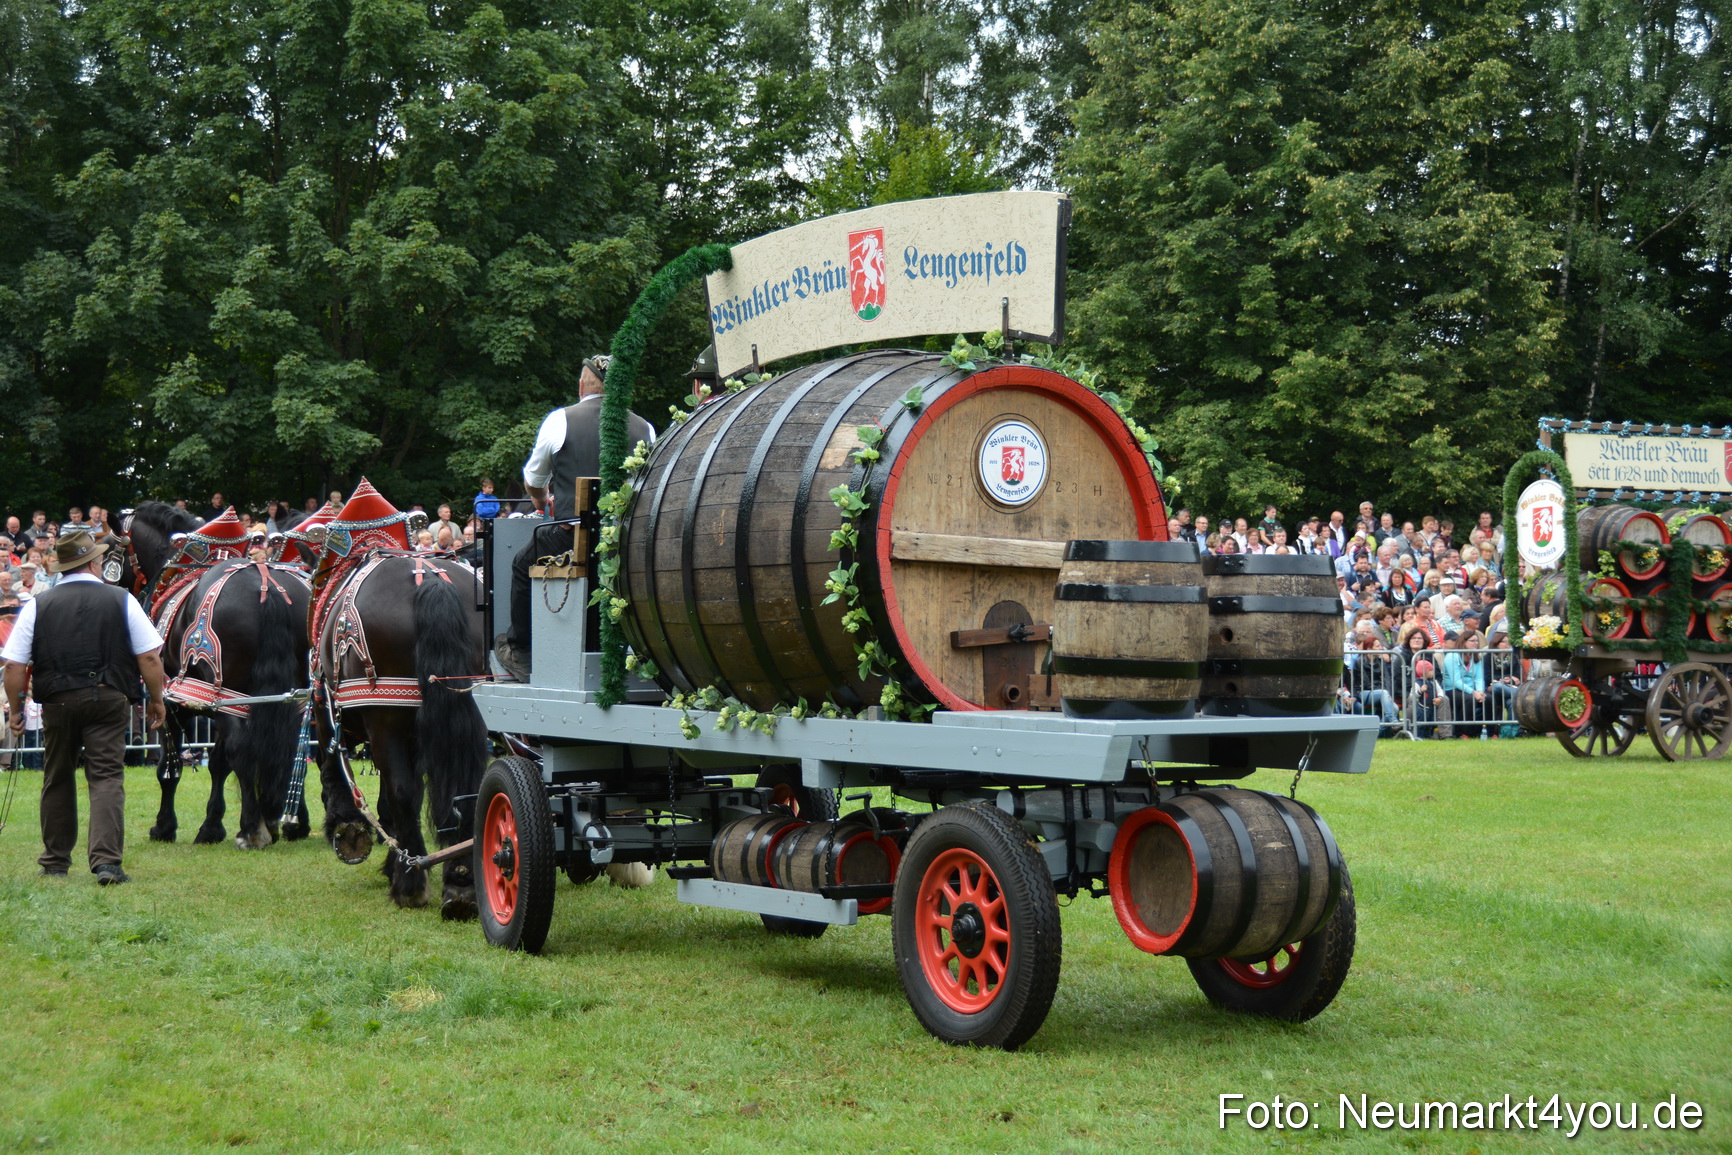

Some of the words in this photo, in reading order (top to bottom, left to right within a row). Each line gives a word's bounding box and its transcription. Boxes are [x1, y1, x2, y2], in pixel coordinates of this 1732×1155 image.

[712, 279, 790, 335] Winkler
[792, 260, 848, 299] Bräu
[903, 241, 1027, 289] Lengenfeld
[989, 434, 1018, 447] Winkler
[1020, 435, 1038, 450] Bräu
[1600, 438, 1661, 461] Winkler
[1665, 440, 1708, 463] Bräu
[1614, 465, 1642, 482] 1628
[1644, 466, 1669, 483] und
[1671, 466, 1720, 487] dennoch
[996, 482, 1030, 497] Lengenfeld
